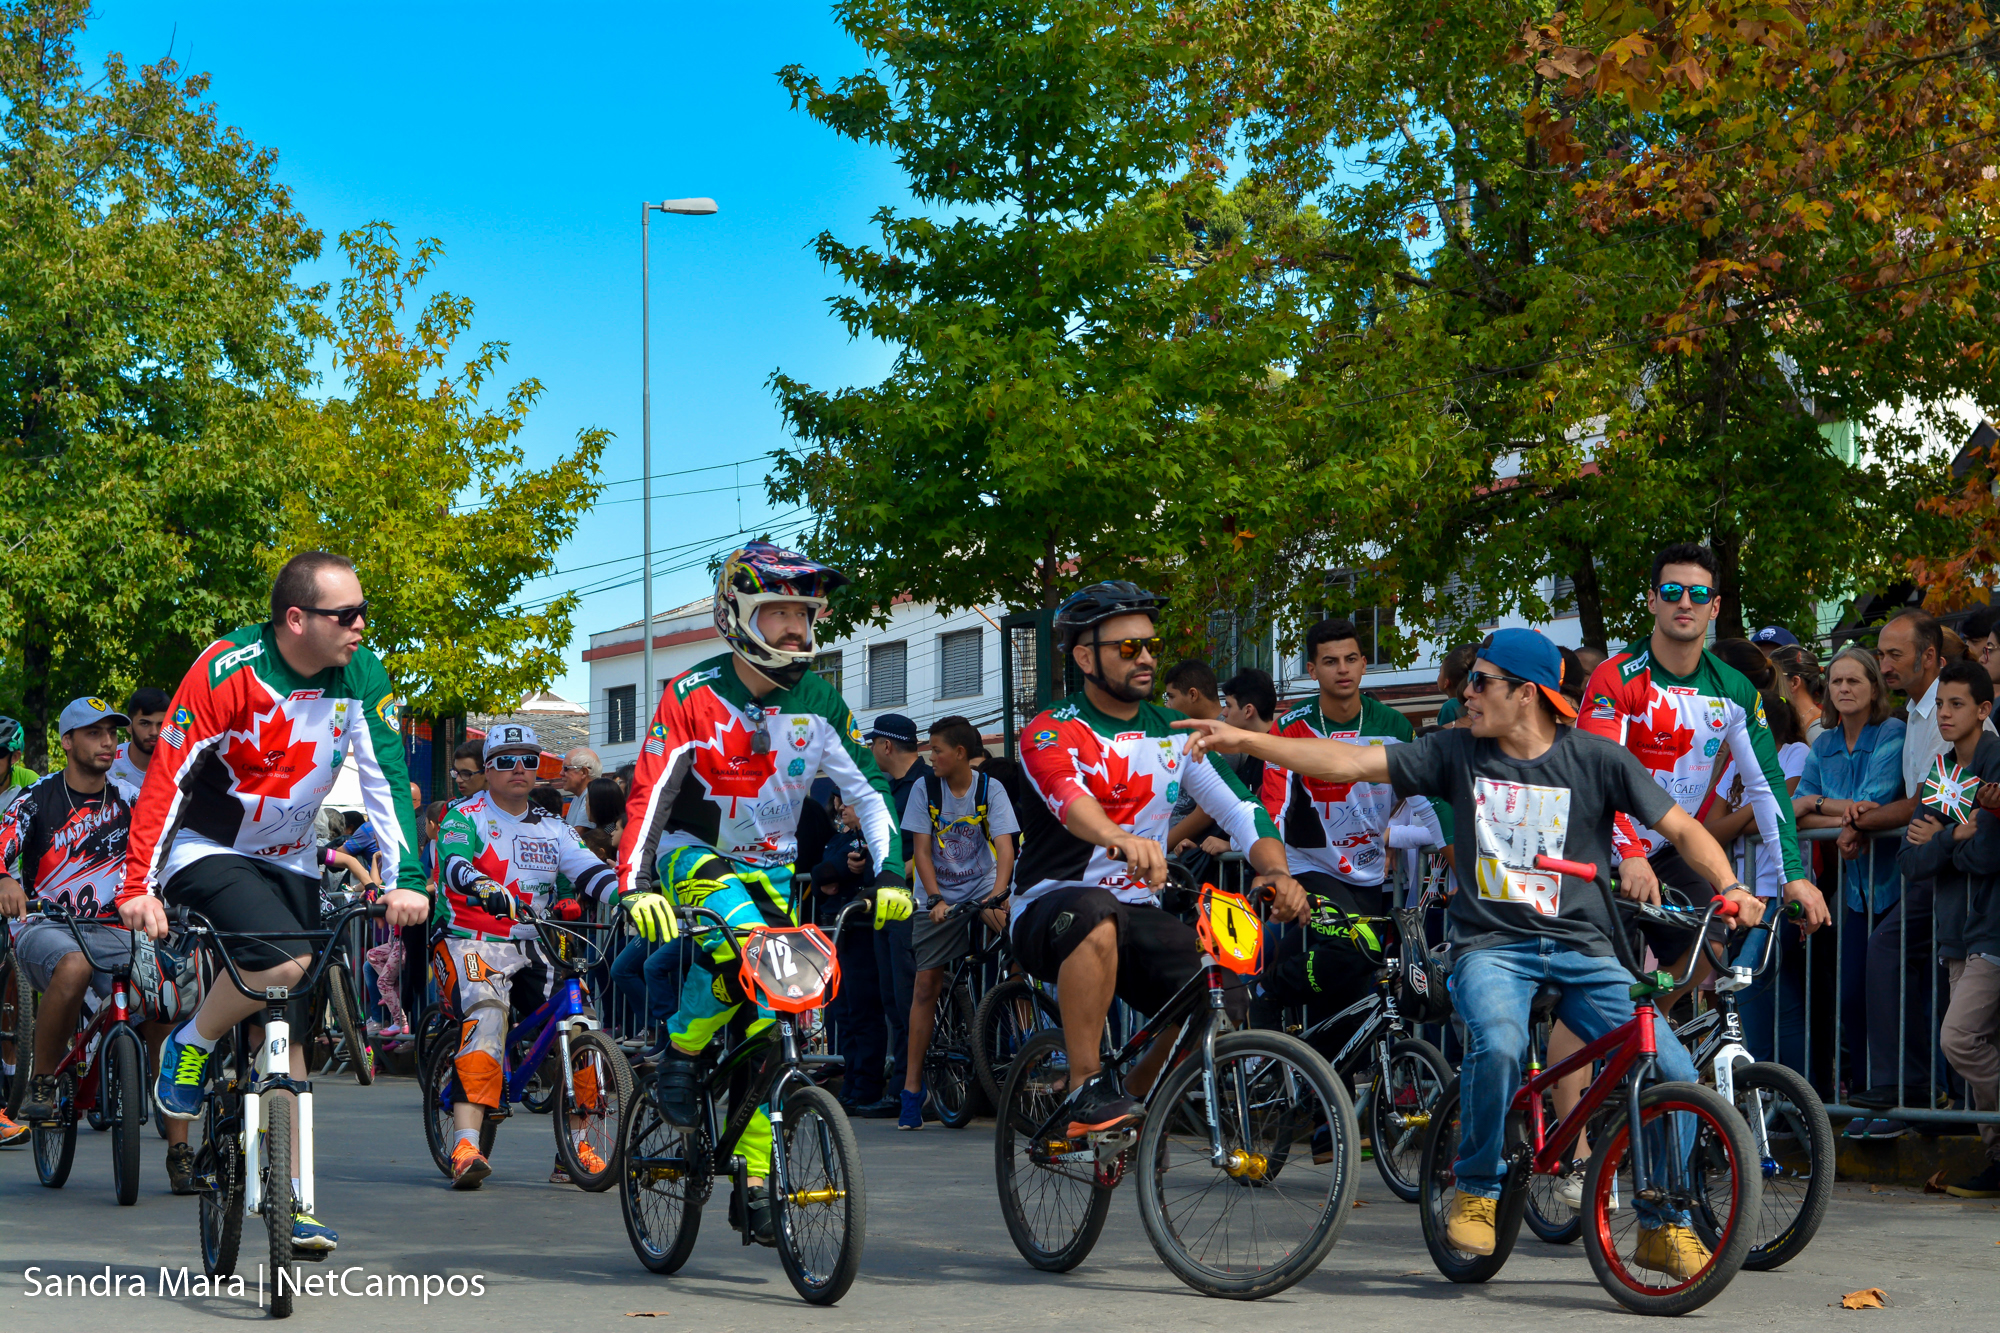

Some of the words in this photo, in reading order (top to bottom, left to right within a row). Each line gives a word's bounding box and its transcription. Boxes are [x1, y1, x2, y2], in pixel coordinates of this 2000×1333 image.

[710, 767, 739, 776] CANADA
[742, 768, 764, 777] LODGE
[53, 801, 123, 853] MADRUGA
[520, 840, 559, 855] DONA
[520, 851, 558, 865] CHICA
[934, 865, 975, 878] alifornia
[1480, 859, 1558, 916] VER
[1226, 907, 1238, 944] 4
[765, 934, 799, 981] 12
[1306, 950, 1323, 994] PENKS
